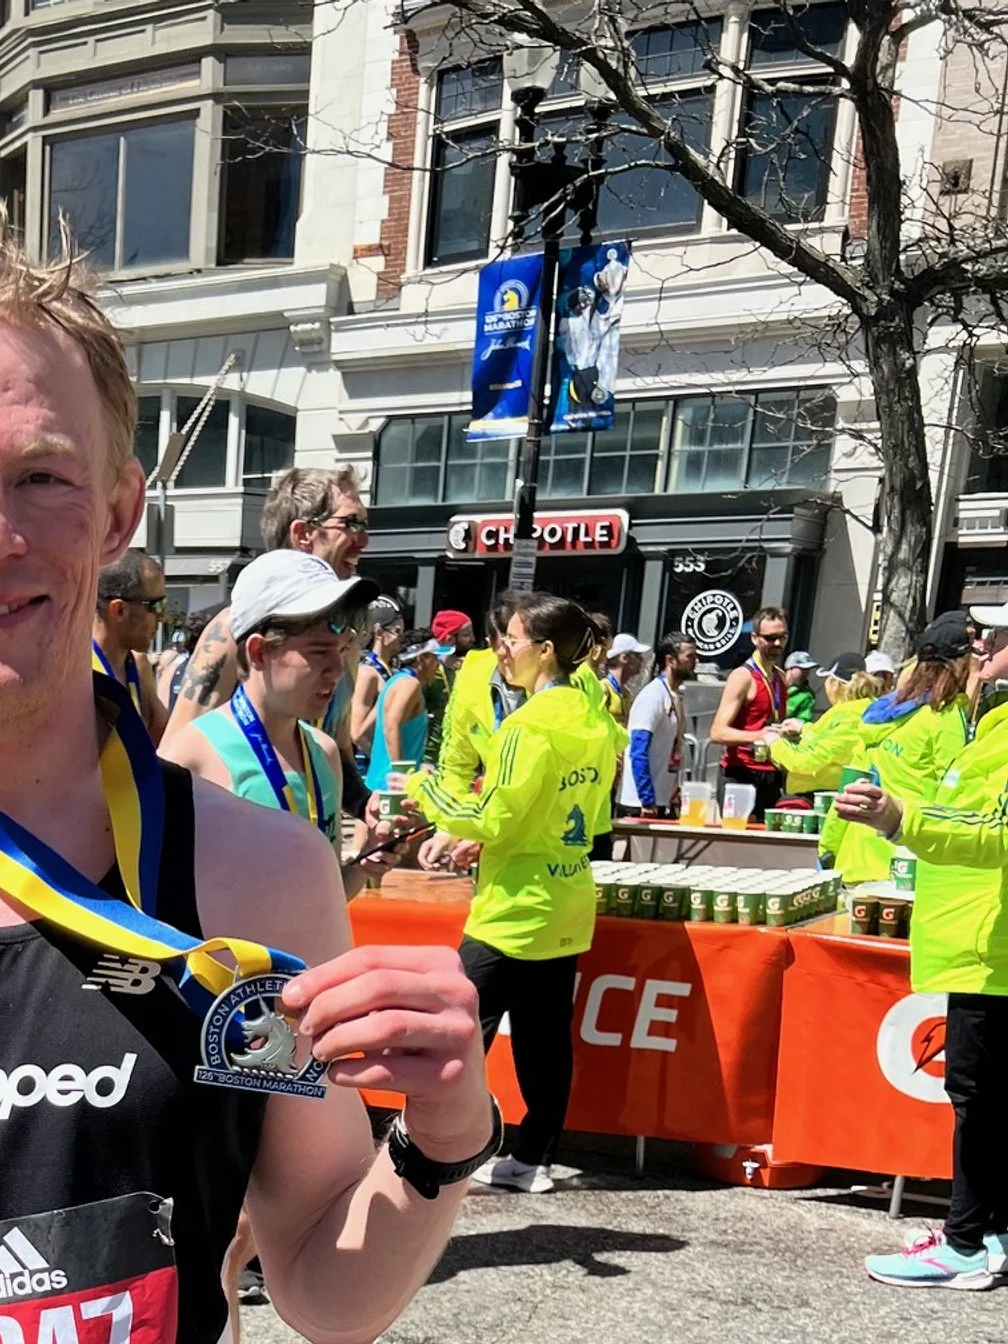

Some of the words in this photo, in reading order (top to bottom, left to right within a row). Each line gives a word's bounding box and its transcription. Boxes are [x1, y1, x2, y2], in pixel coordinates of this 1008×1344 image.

[480, 520, 611, 547] CHPOTLE
[673, 557, 706, 573] 553
[686, 594, 739, 620] CHIPOTLE
[618, 888, 629, 899] G
[641, 889, 652, 901] G
[663, 891, 674, 903] G
[716, 894, 729, 907] G
[767, 897, 780, 910] G
[855, 905, 868, 917] G
[882, 908, 895, 920] G
[573, 972, 692, 1053] CE
[207, 1003, 230, 1066] BOSTON
[230, 979, 289, 1007] ATHLET
[218, 1072, 262, 1089] BOSTON
[262, 1079, 326, 1097] MARATHON
